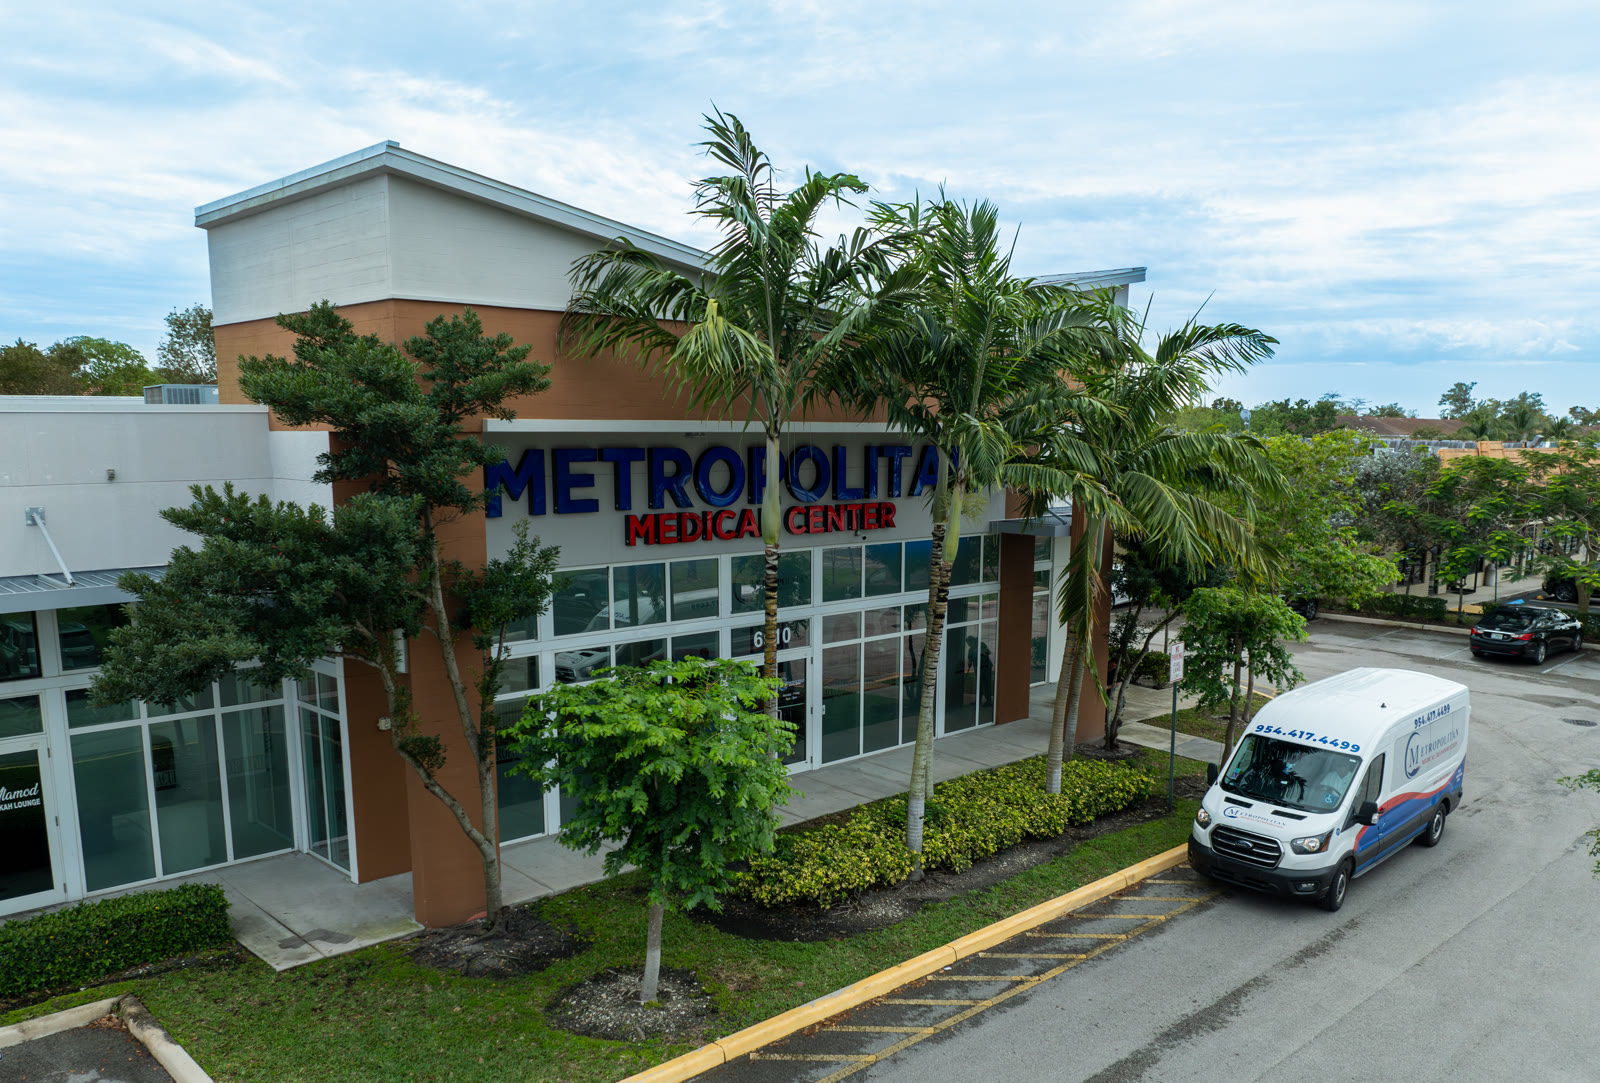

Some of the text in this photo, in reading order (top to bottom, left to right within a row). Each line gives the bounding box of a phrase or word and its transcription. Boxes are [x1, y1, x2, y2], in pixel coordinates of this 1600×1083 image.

[484, 446, 979, 518] METROPOLITA
[624, 502, 896, 547] MEDICA CENTER
[754, 627, 791, 648] 610
[1414, 704, 1450, 729] 954.417.4499
[1255, 724, 1361, 753] 954.417.4499
[14, 798, 41, 809] LOUNGE
